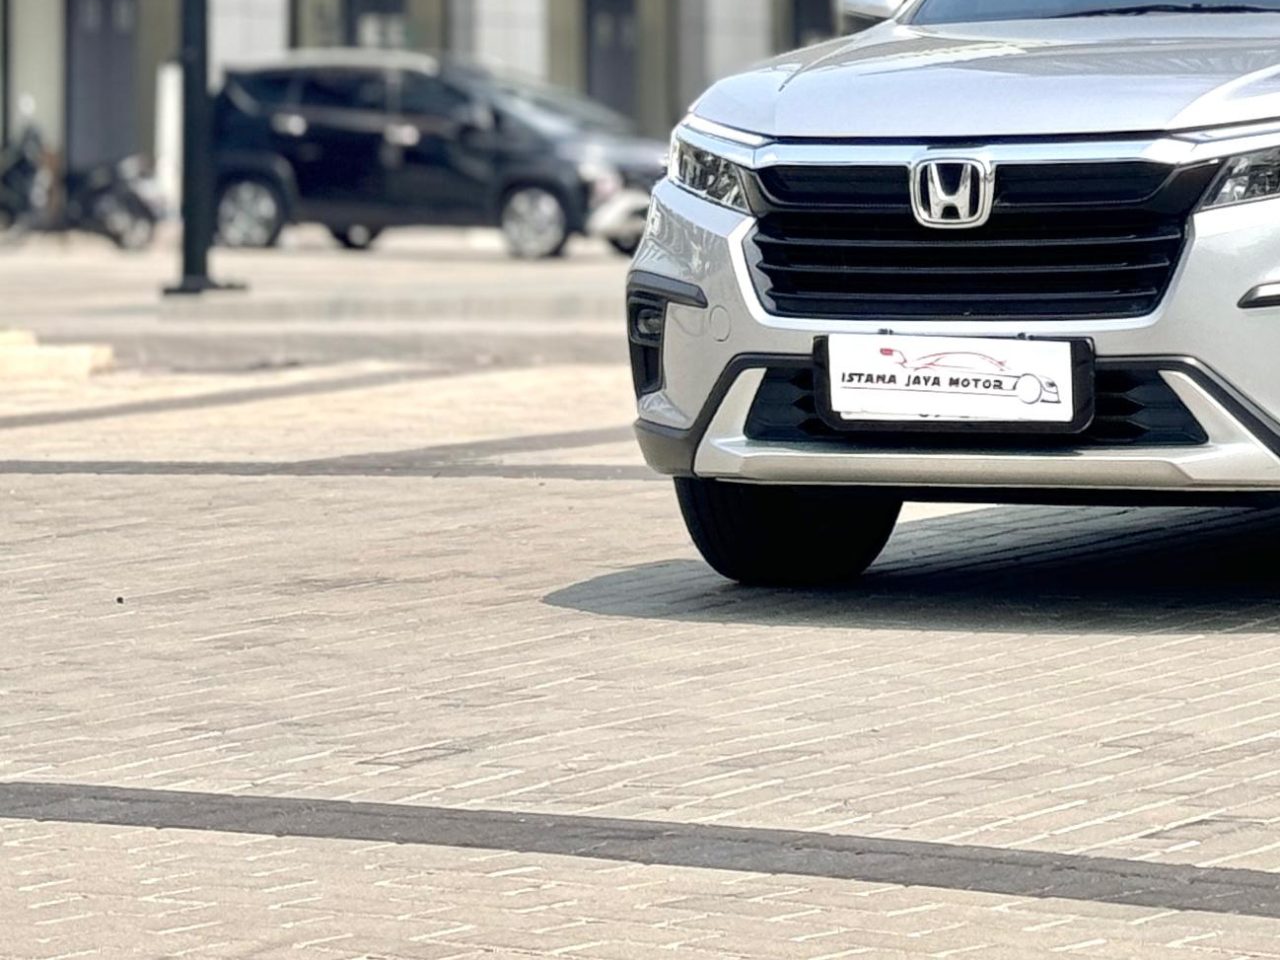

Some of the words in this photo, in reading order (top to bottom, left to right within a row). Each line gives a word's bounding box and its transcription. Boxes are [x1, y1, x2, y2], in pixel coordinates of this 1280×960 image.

[841, 371, 897, 385] ISTANA
[905, 374, 941, 388] JAYA
[948, 376, 1004, 391] MOTOR
